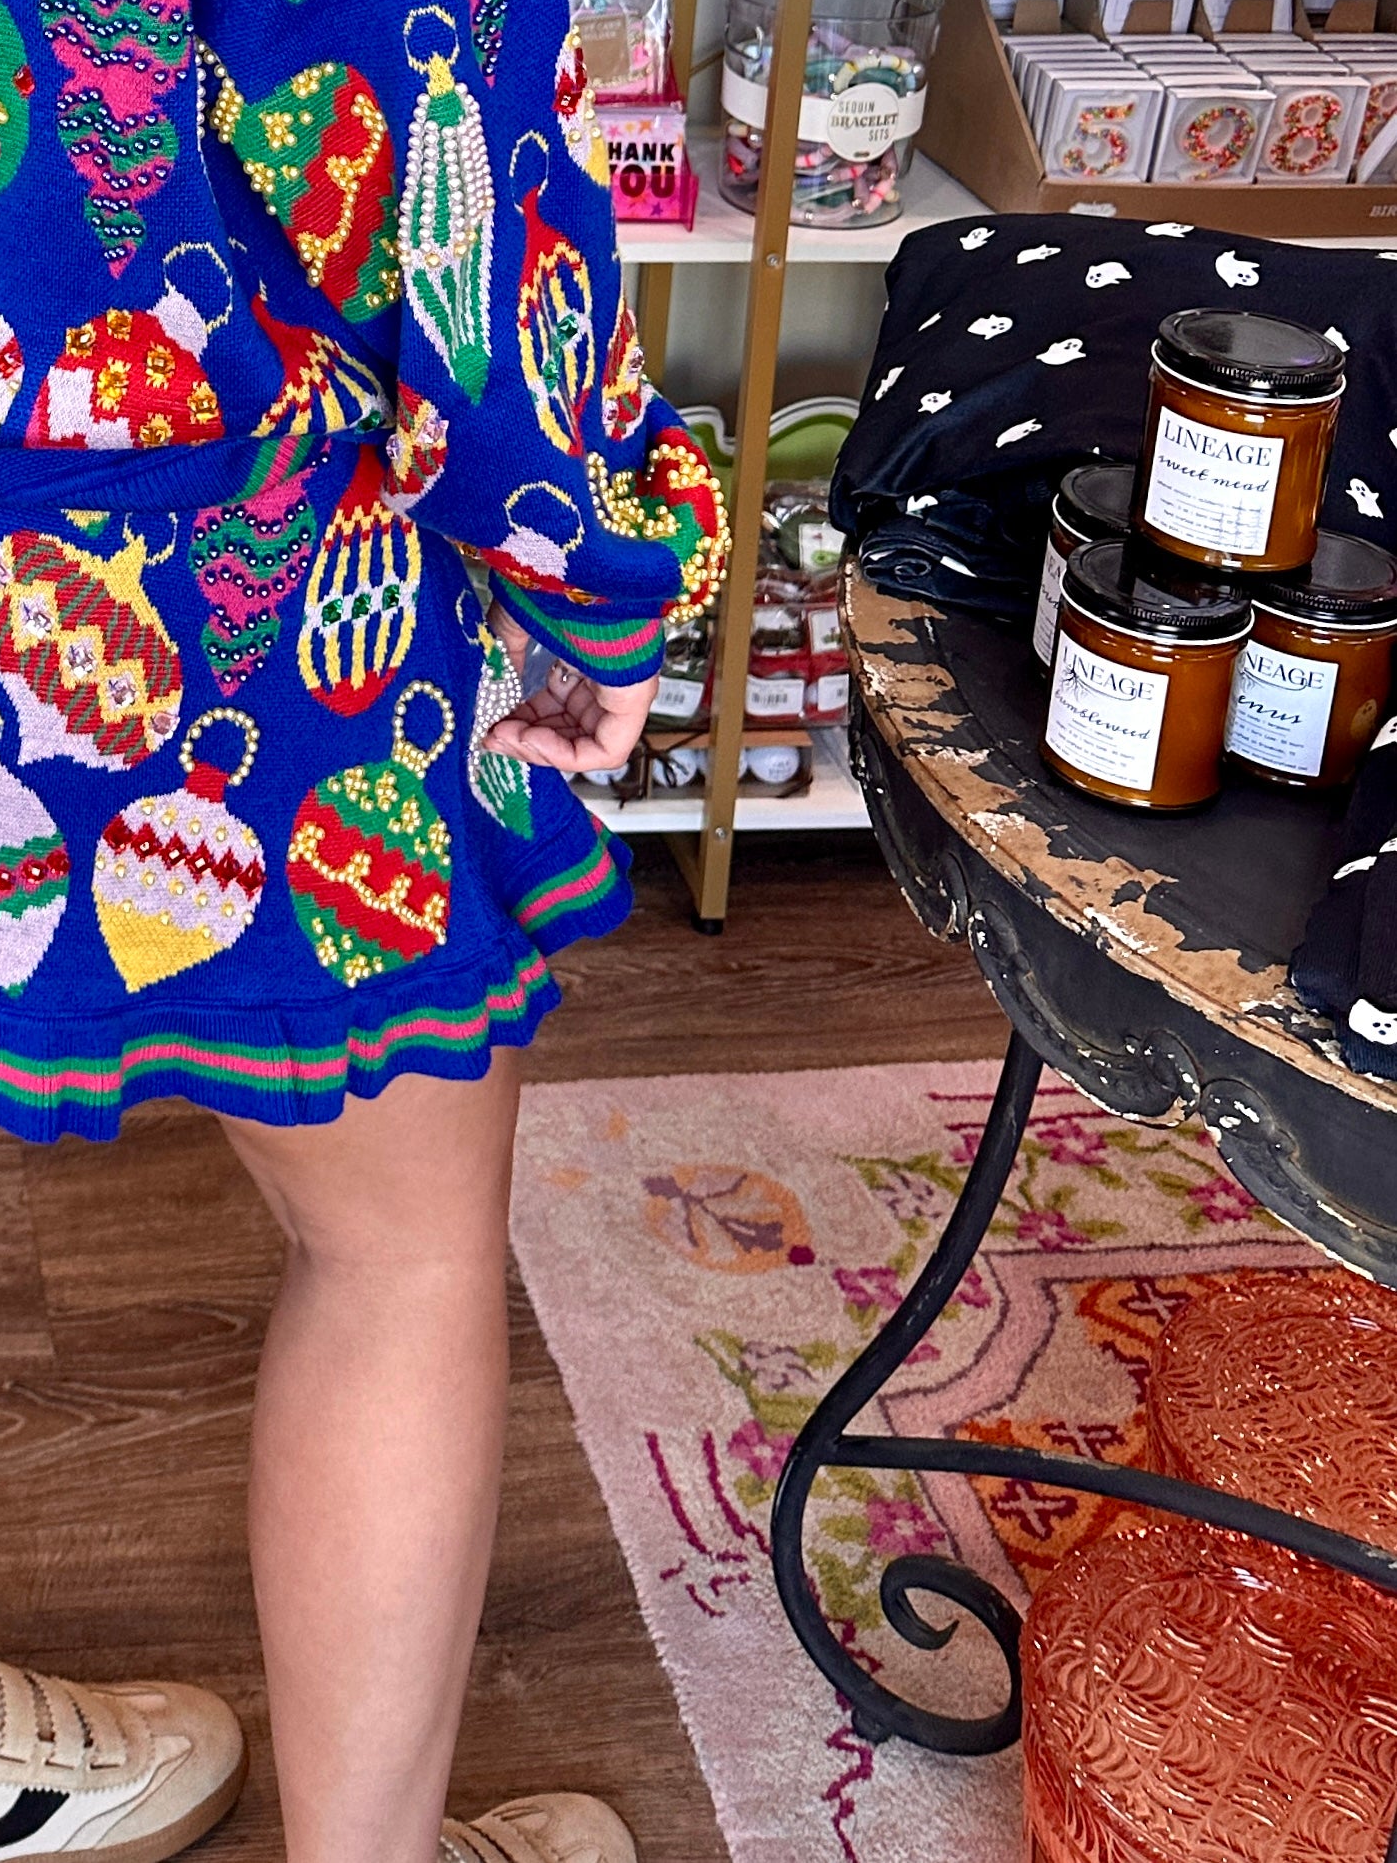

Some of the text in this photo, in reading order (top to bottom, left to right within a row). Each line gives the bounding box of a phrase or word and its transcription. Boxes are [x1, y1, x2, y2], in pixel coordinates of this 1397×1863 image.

[830, 112, 899, 130] BRACELET
[868, 128, 890, 142] SETS
[608, 142, 676, 162] HANK
[1163, 419, 1273, 467] LINEAGE
[1157, 454, 1271, 493] sweet mead
[1246, 650, 1325, 690] NEAGE
[1237, 694, 1302, 725] enus
